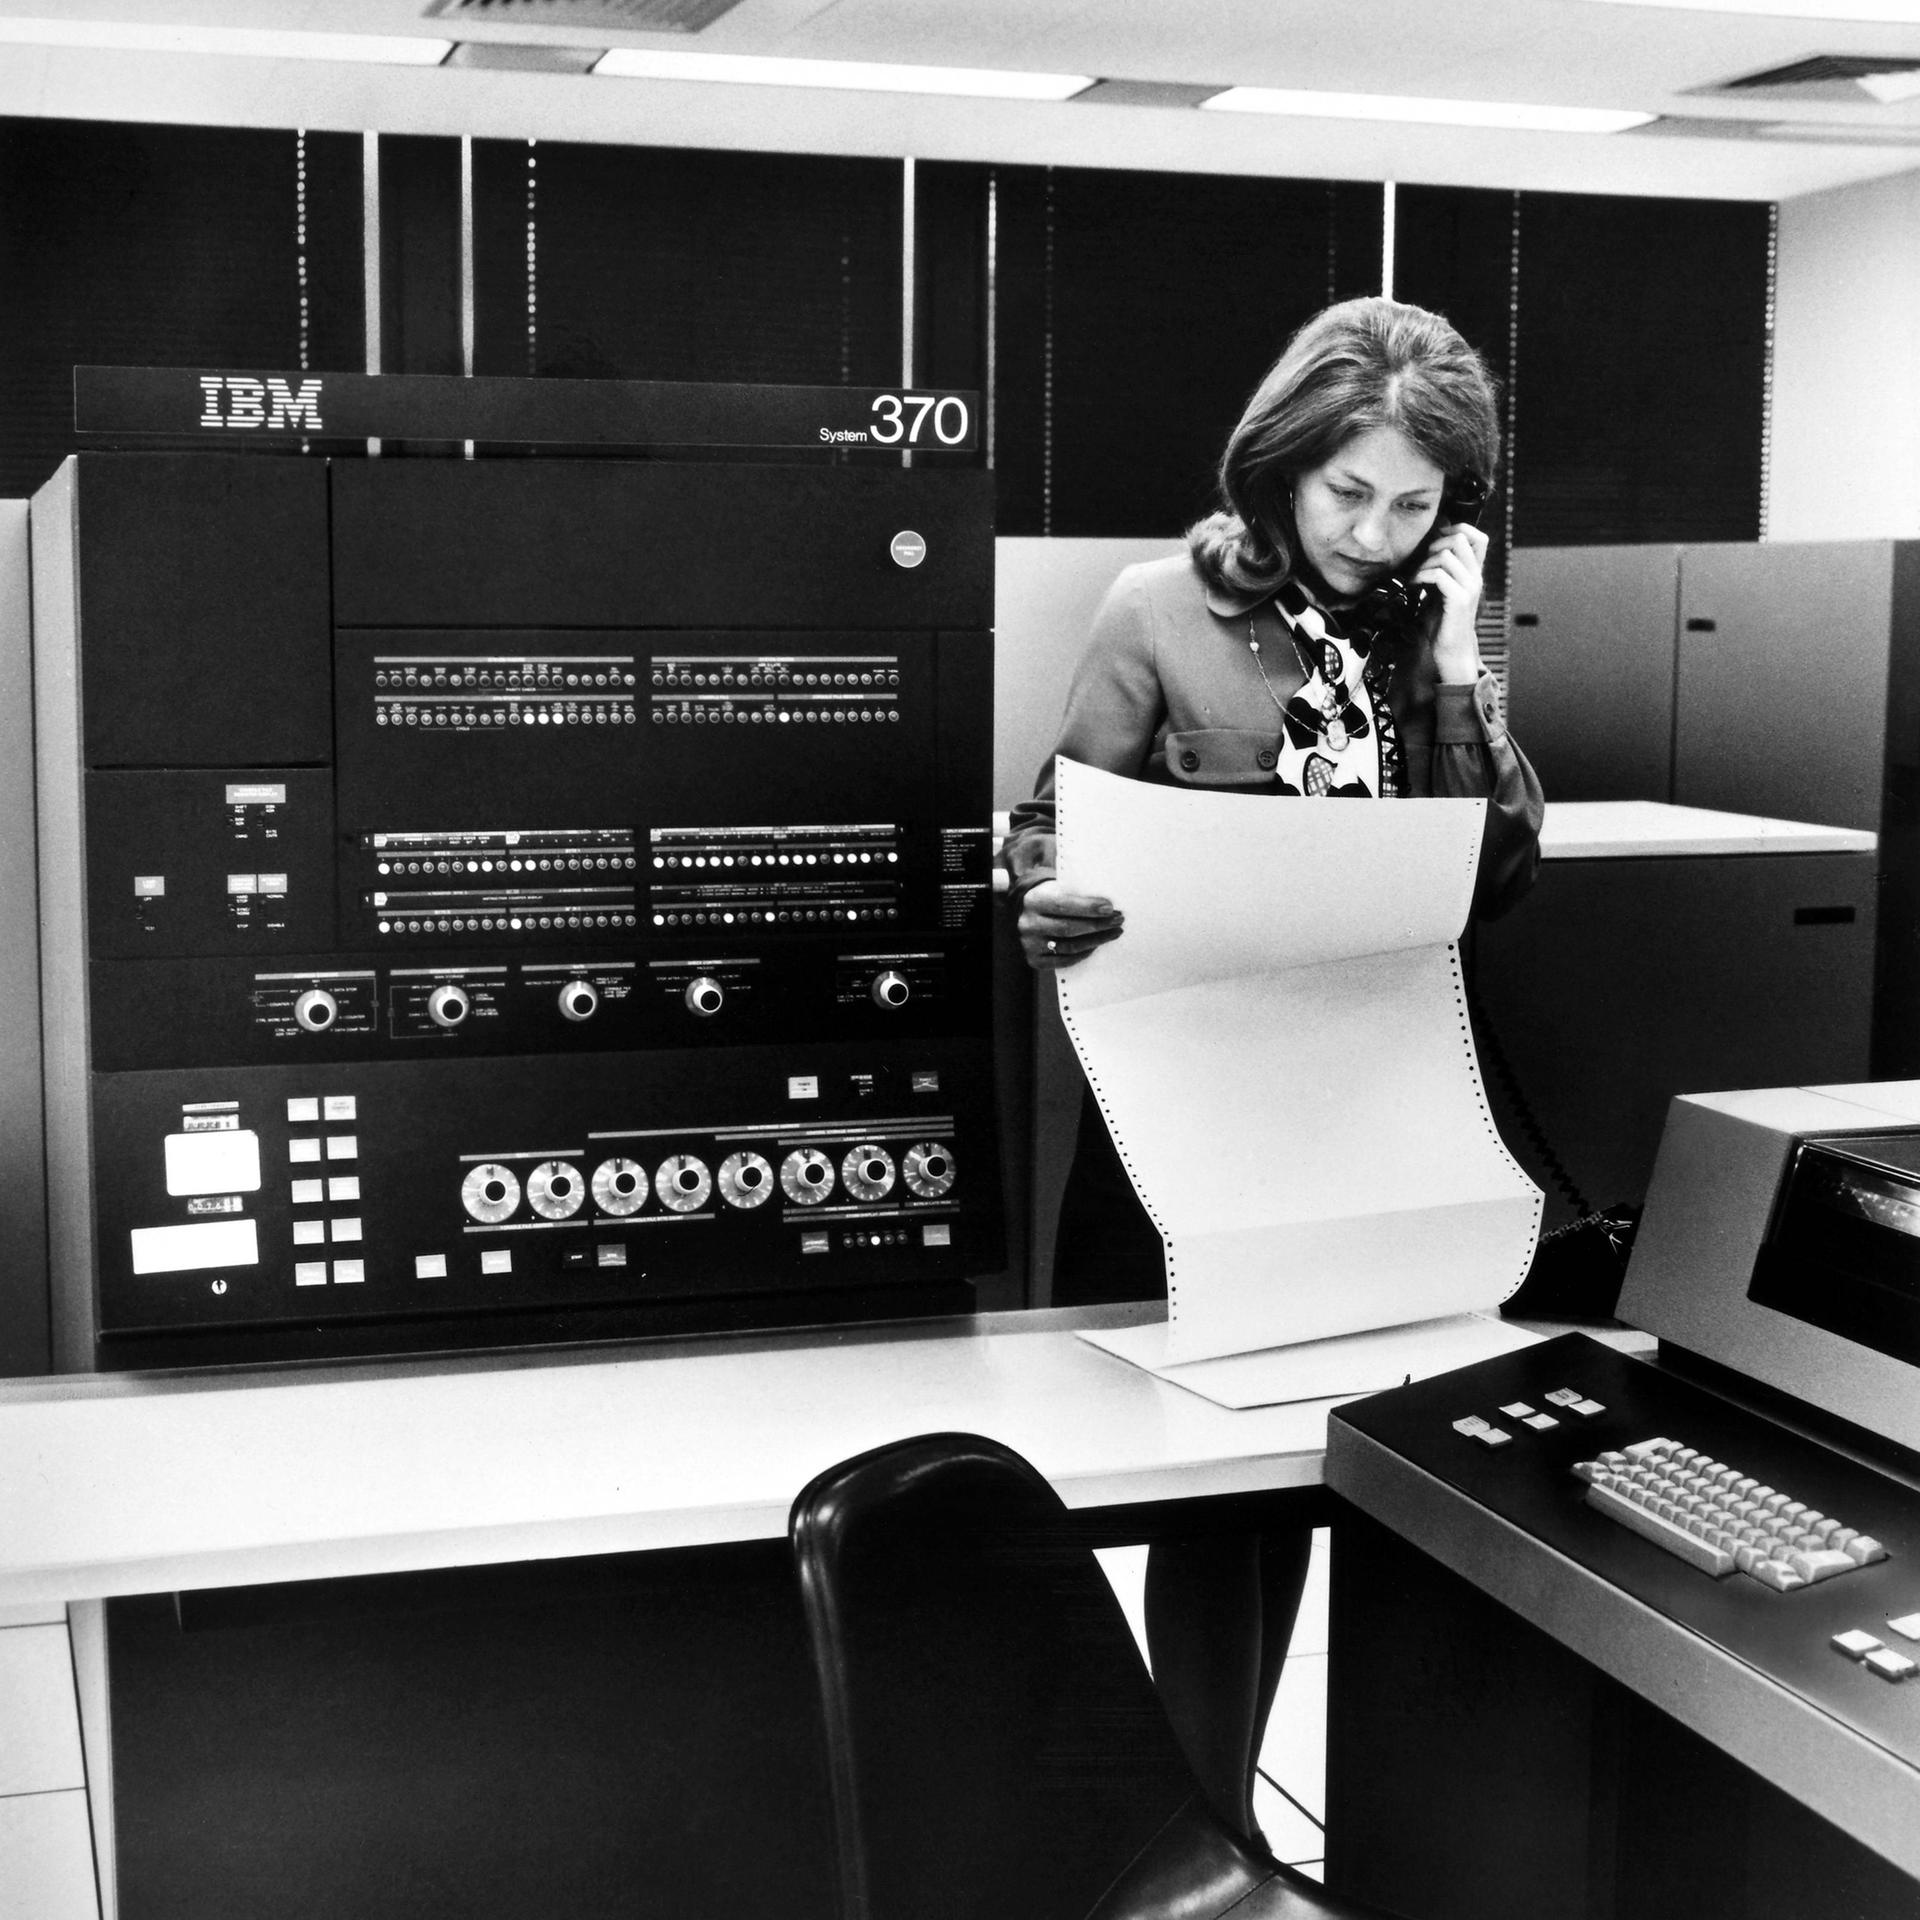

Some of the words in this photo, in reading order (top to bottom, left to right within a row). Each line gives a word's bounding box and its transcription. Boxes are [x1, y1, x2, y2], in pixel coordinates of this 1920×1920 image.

[200, 376, 323, 429] IBM
[819, 427, 868, 443] System
[870, 394, 969, 445] 370
